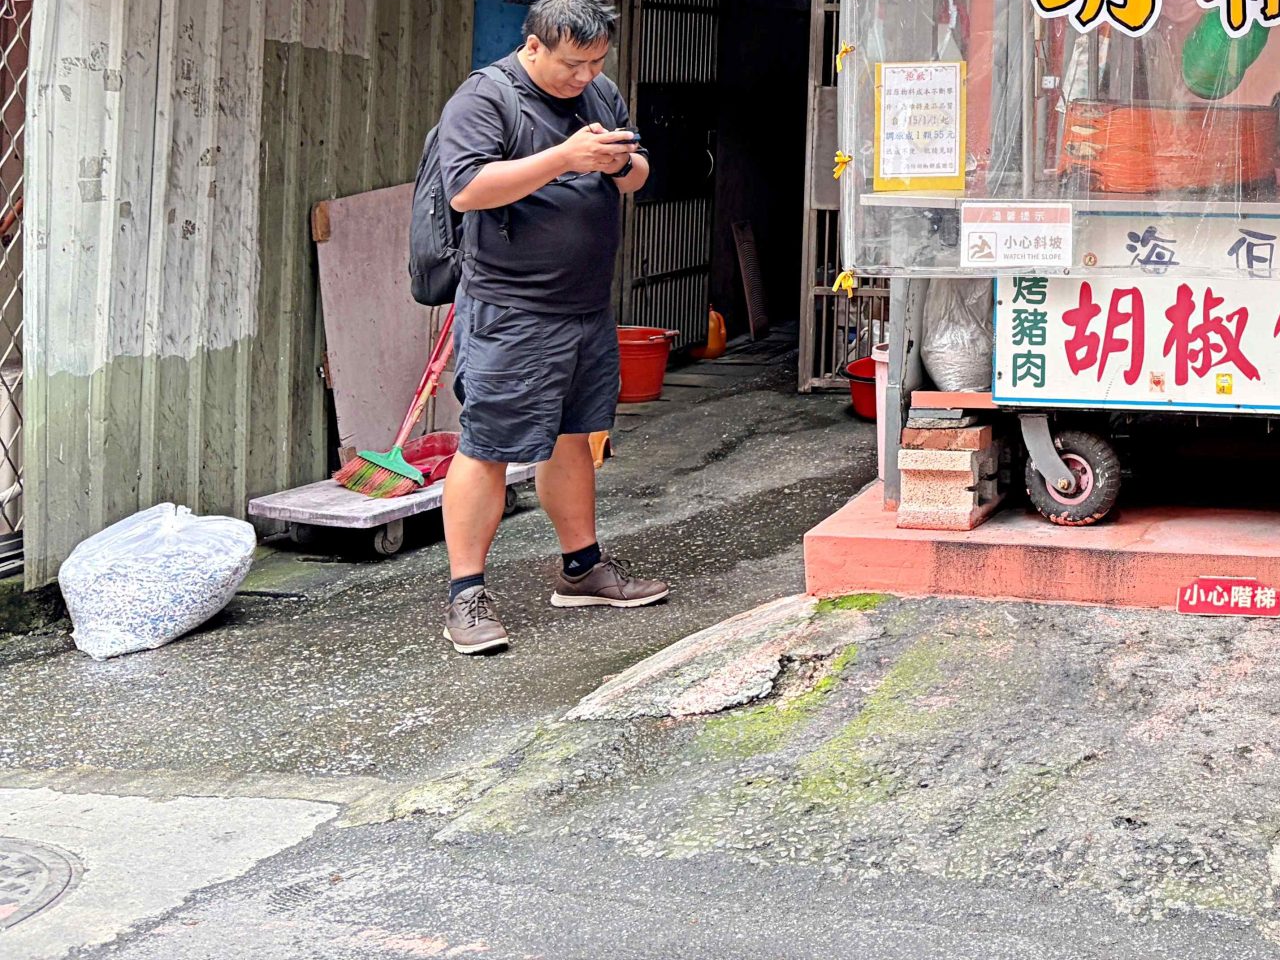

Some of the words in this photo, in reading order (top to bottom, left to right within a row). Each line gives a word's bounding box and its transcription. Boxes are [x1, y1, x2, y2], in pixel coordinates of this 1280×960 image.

[1003, 235, 1063, 250] 小心斜坡
[1003, 253, 1026, 261] WATCH
[1028, 253, 1040, 261] THE
[1041, 253, 1062, 261] SLOPE
[1012, 270, 1049, 388] 烤豬肉
[1183, 584, 1278, 609] 小心階梯
